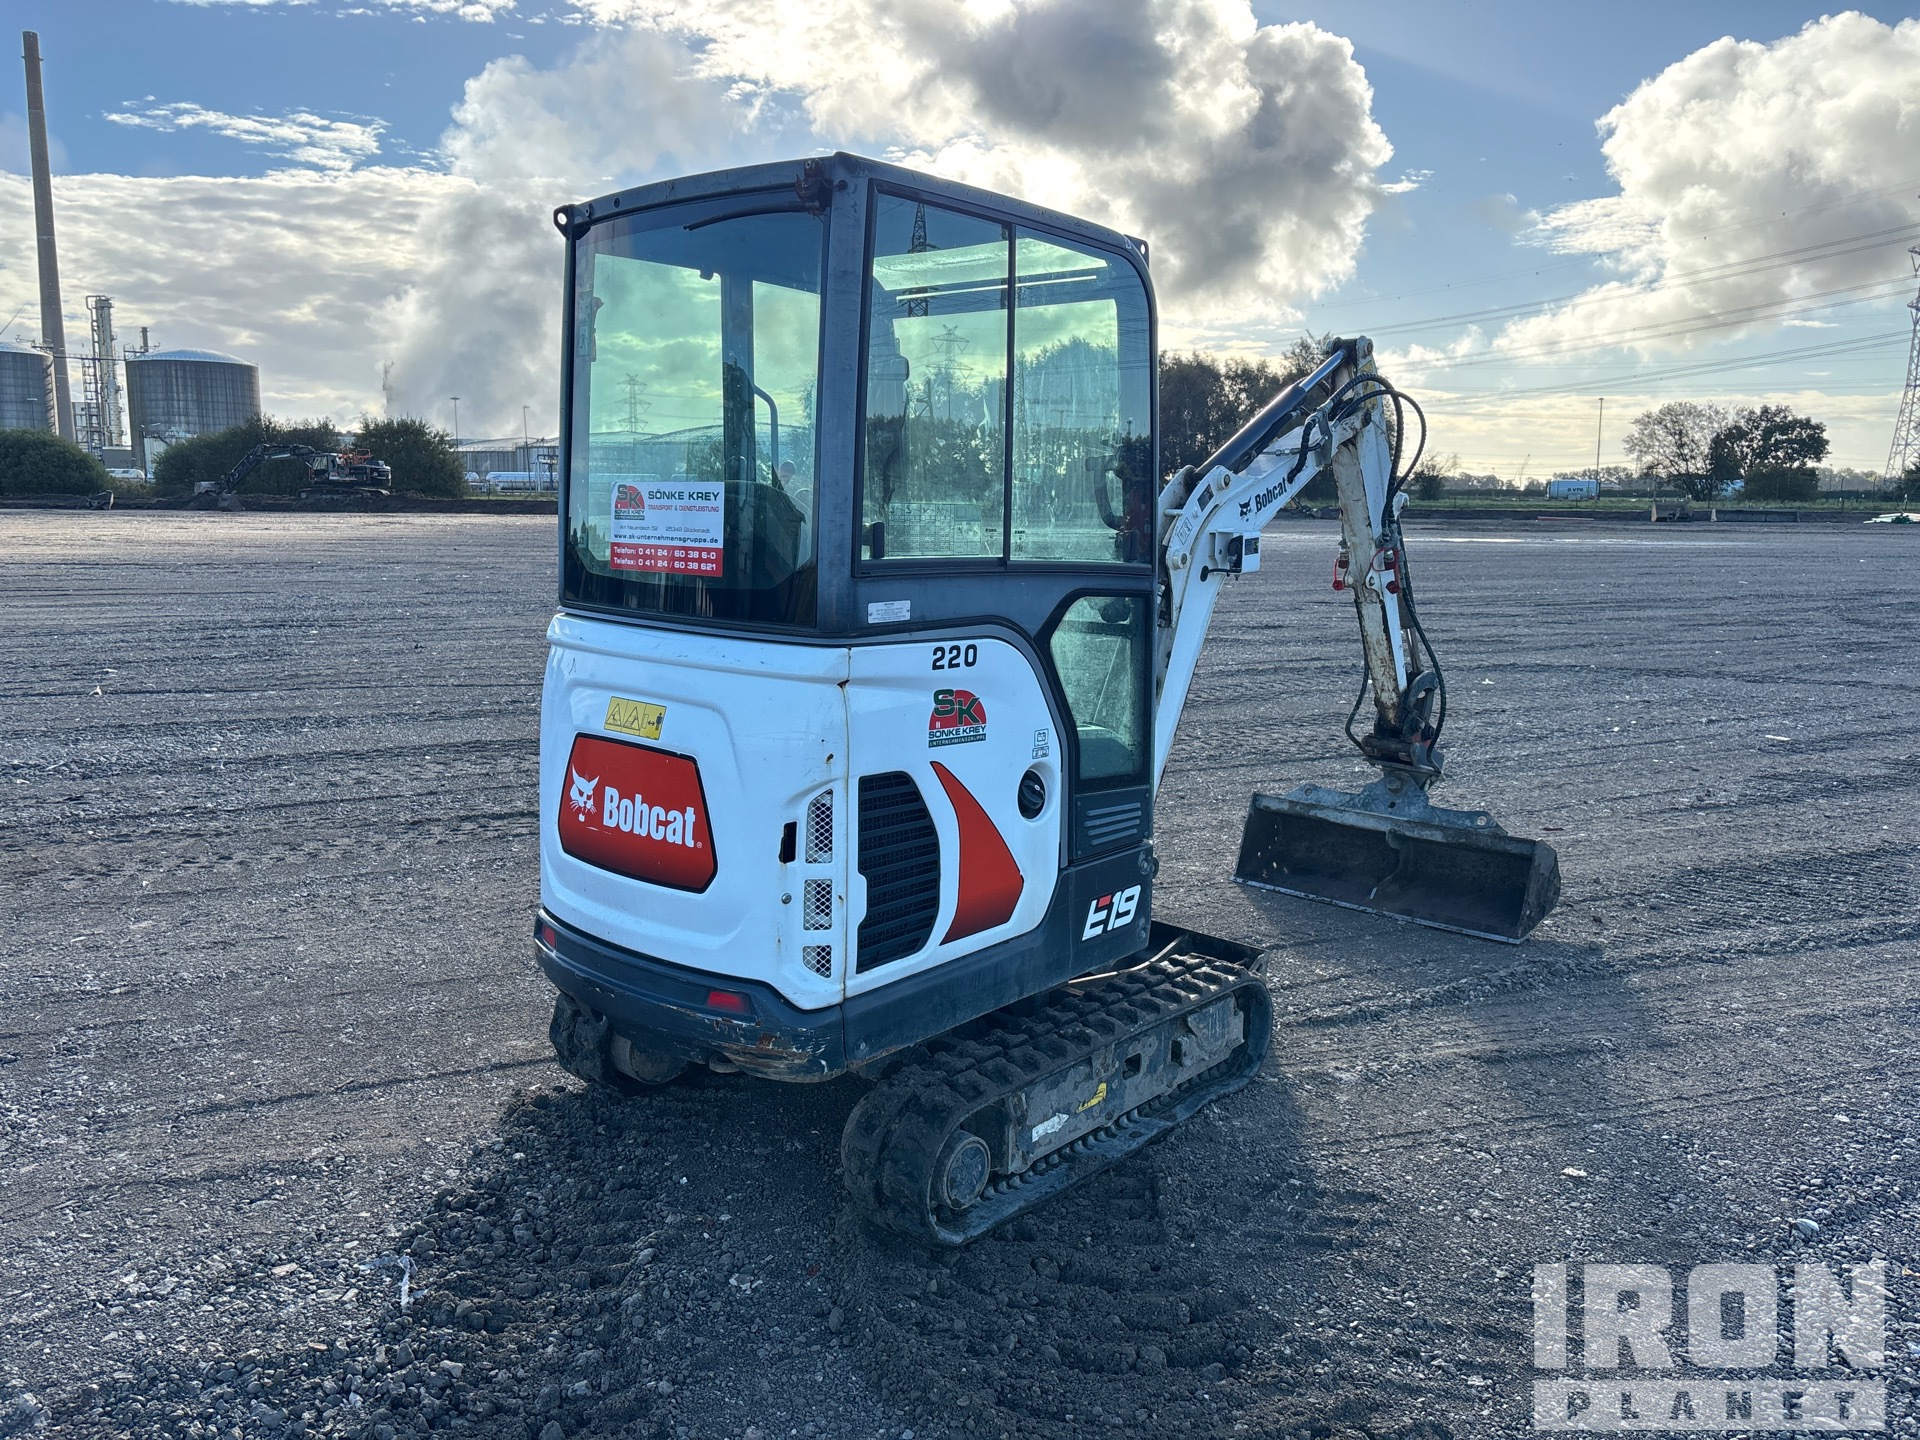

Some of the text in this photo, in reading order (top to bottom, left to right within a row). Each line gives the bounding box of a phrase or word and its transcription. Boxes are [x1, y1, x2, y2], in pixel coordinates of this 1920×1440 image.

[617, 484, 641, 509] SK
[648, 489, 720, 501] SÖNKE KREY
[1255, 477, 1287, 512] Bobcat
[679, 505, 720, 513] DIENSTLEISTUNG
[614, 533, 718, 544] www.sk-unternehmensgruppe.de
[614, 546, 636, 555] Telefon:
[638, 547, 643, 555] 0
[645, 548, 655, 556] 41
[657, 548, 668, 556] 24
[674, 550, 685, 558] 60
[687, 551, 699, 559] 38
[614, 557, 636, 565] Telefax:
[638, 558, 643, 566] 0
[645, 559, 655, 567] 41
[657, 559, 668, 568] 24
[674, 561, 685, 569] 60
[932, 644, 978, 670] 220
[933, 689, 981, 726] SK
[962, 725, 987, 735] KREY
[930, 734, 986, 747] UNTERNEHMENSGRUPPE
[603, 786, 696, 848] Bobcat
[1081, 884, 1142, 941] E19
